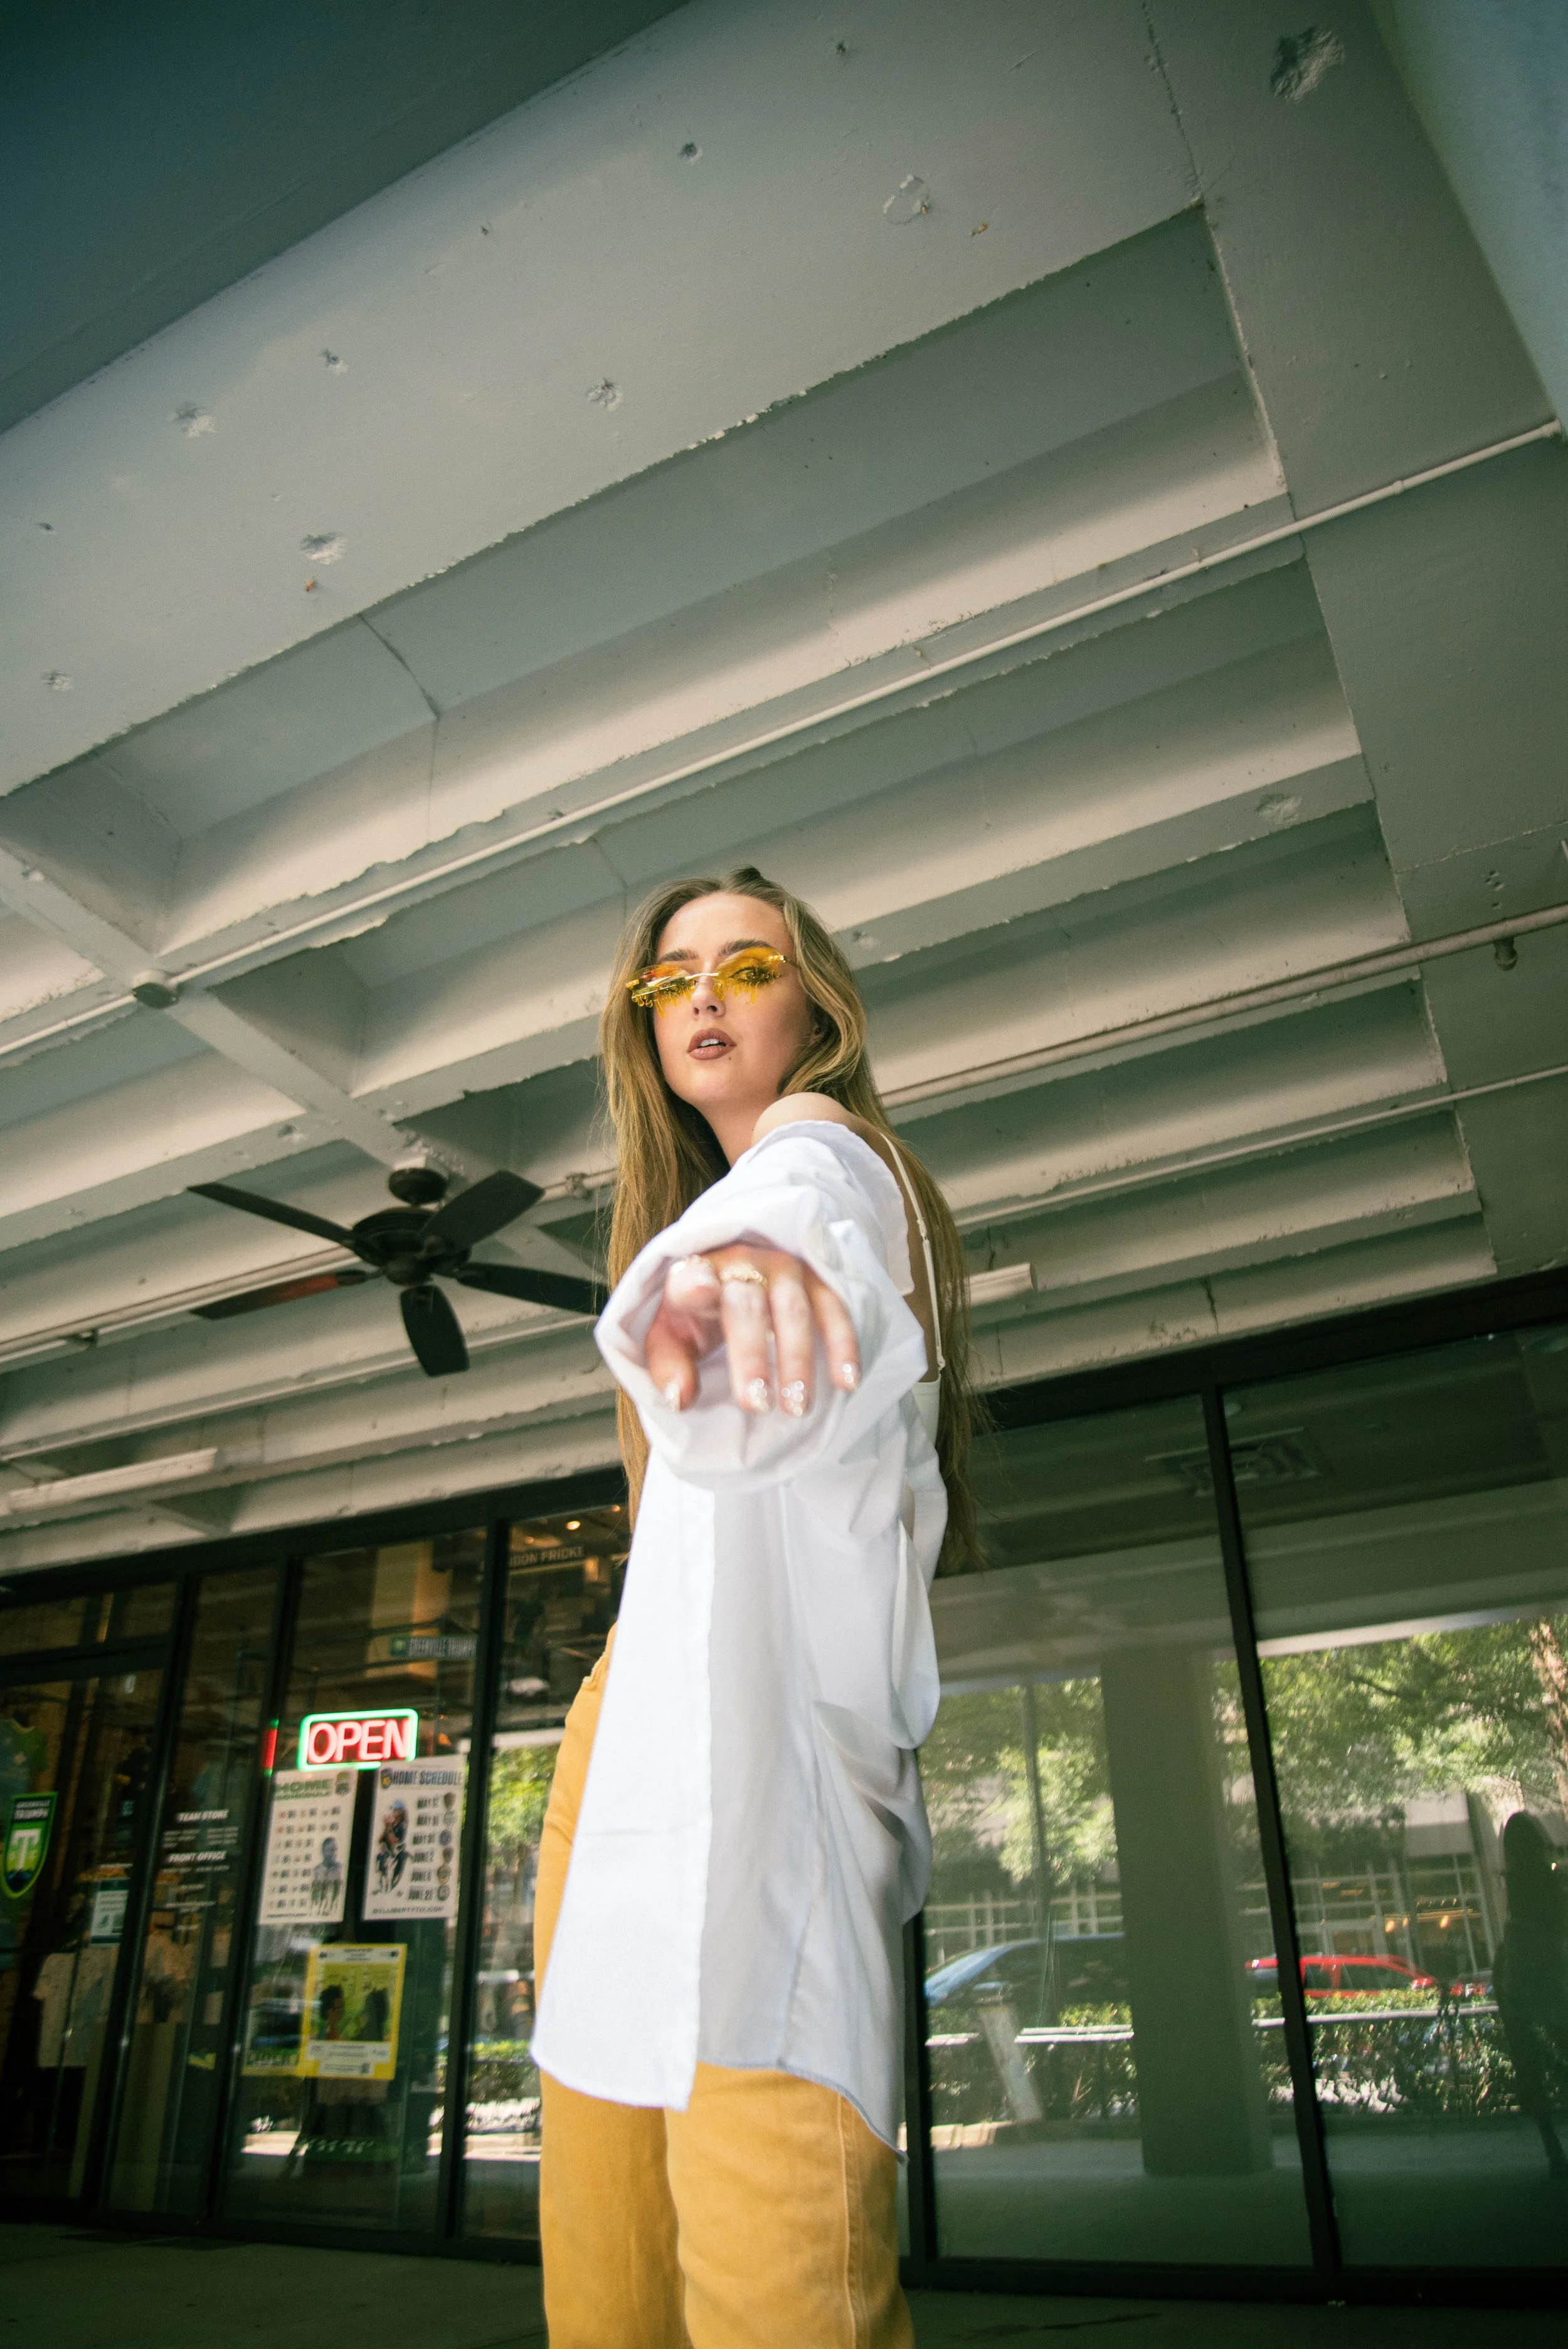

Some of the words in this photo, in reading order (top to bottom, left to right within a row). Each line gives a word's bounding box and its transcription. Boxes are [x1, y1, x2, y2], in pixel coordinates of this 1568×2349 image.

[307, 1718, 412, 1764] OPEN
[393, 1771, 418, 1785] HOME
[420, 1770, 463, 1785] SCHEDULE
[177, 1811, 201, 1822] TEAM
[202, 1809, 229, 1820] STORE
[167, 1852, 196, 1864] FRONT
[196, 1851, 226, 1862] OFFICE
